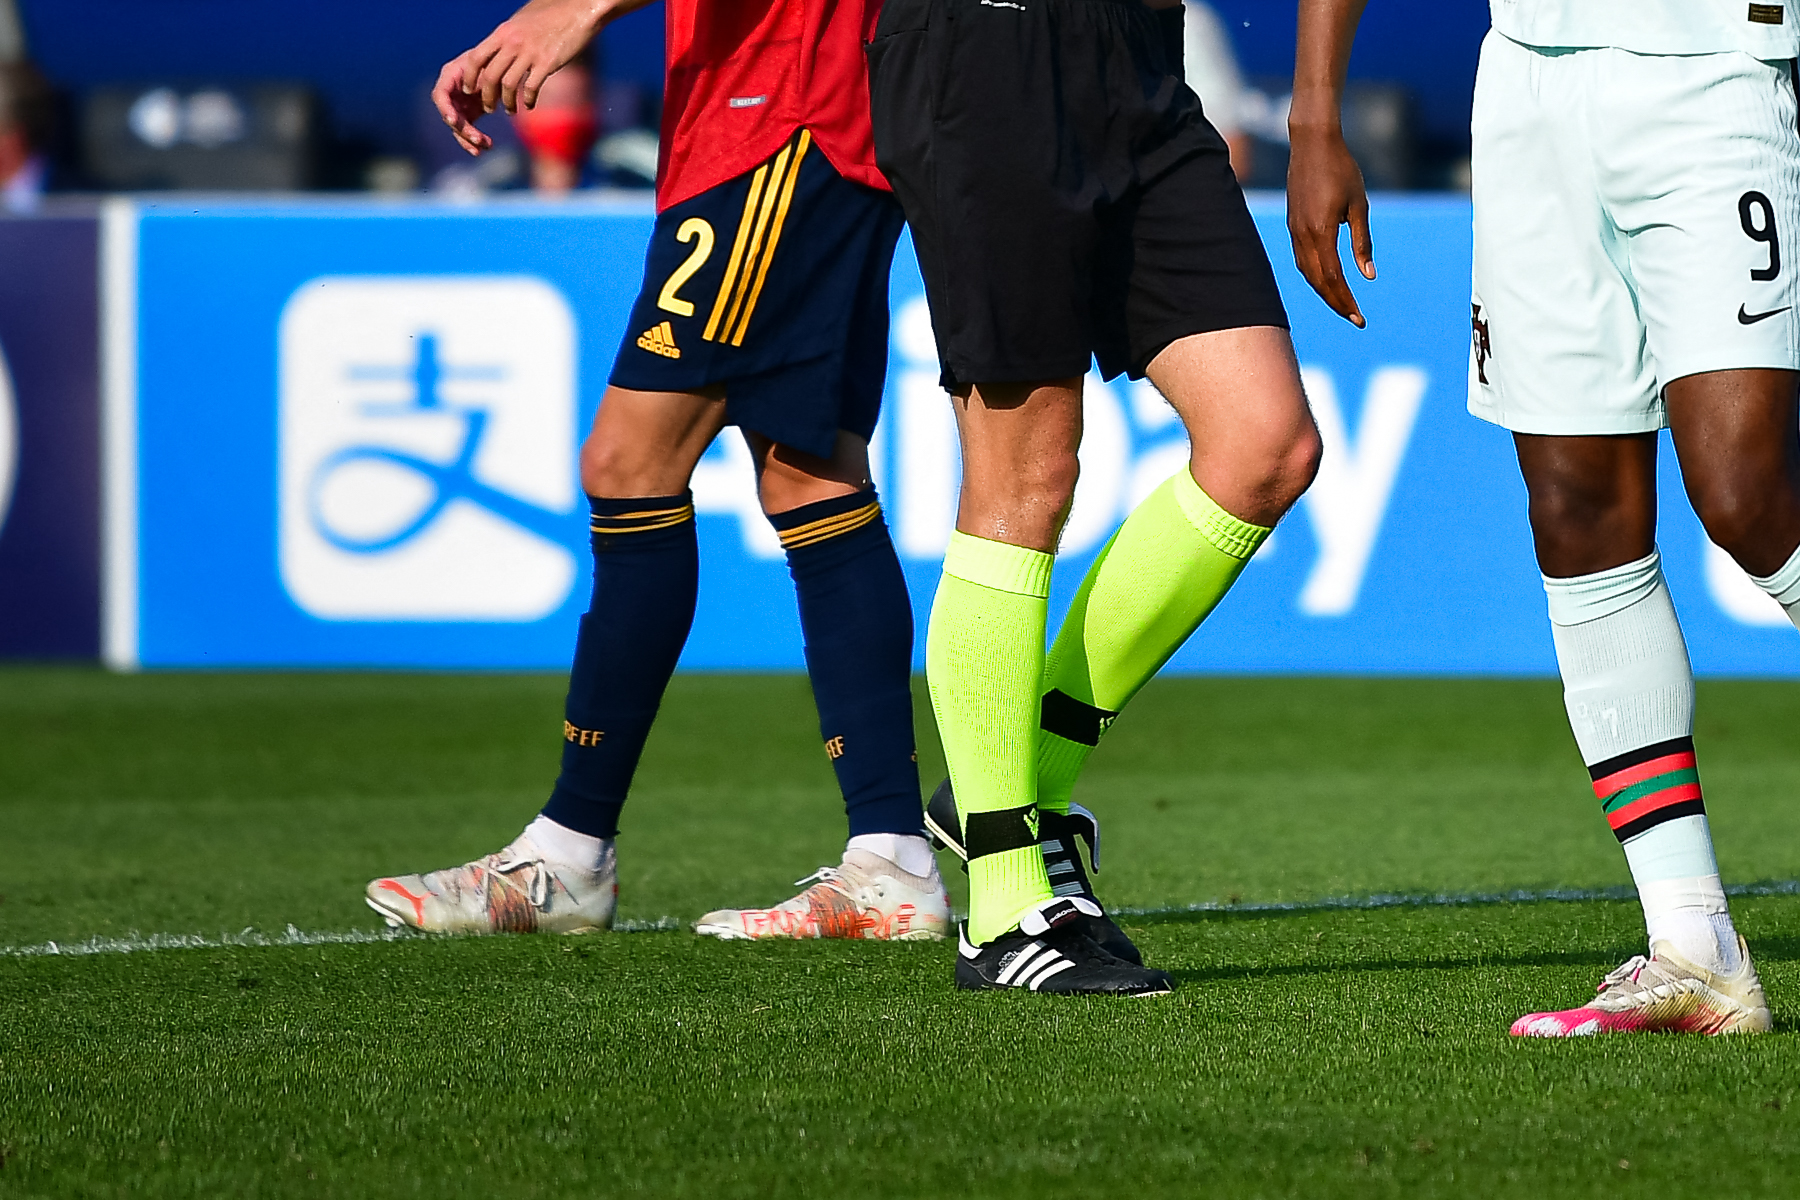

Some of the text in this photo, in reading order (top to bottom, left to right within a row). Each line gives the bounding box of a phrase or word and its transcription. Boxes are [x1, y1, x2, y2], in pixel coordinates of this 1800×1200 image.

[657, 217, 715, 317] 2
[1738, 190, 1781, 281] 9
[636, 336, 682, 360] adidas
